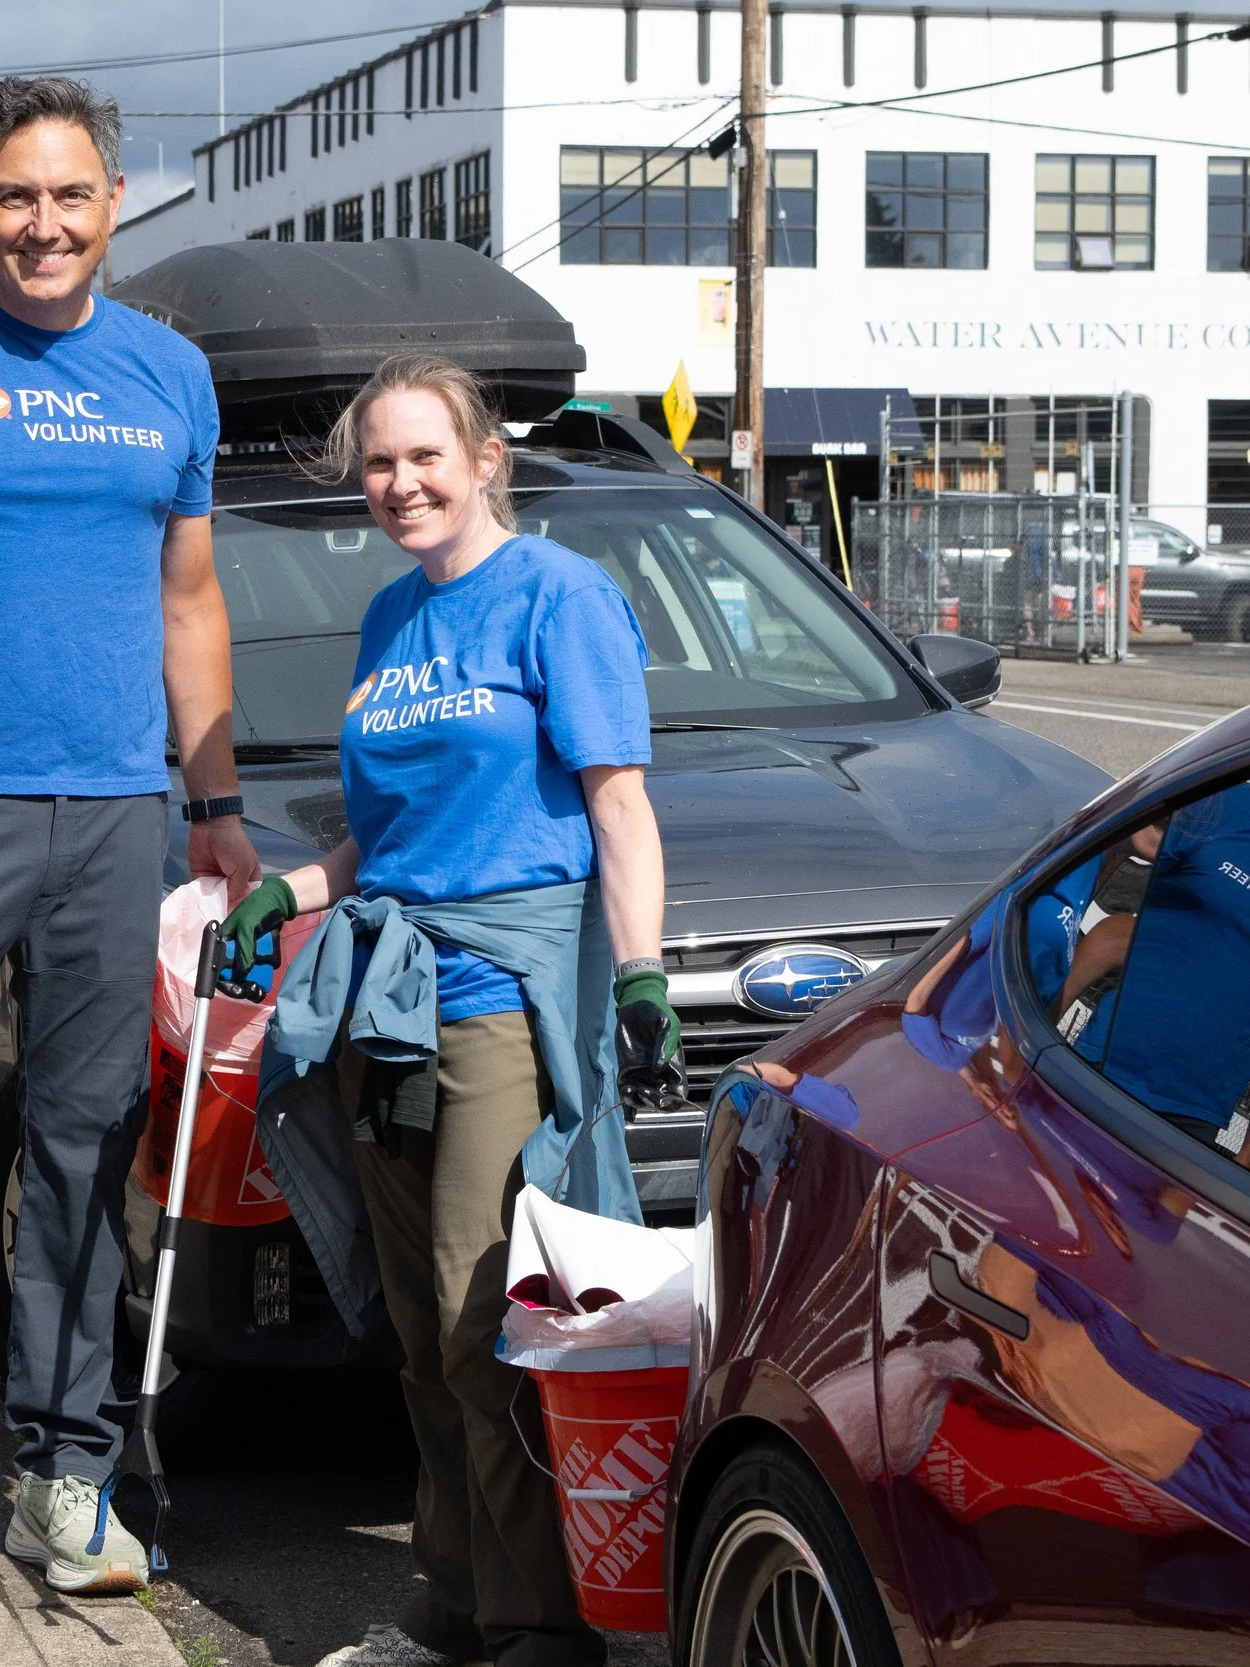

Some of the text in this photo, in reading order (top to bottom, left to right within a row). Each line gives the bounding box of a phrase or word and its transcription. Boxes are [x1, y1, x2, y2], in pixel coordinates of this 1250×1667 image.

[862, 320, 1003, 350] WATER
[1019, 321, 1190, 351] AVENUE
[14, 389, 104, 419] PNC
[23, 422, 165, 450] VOLUNTEER
[372, 656, 449, 702] PNC
[362, 687, 496, 735] VOLUNTEER
[563, 1421, 676, 1581] HOME
[593, 1487, 667, 1588] DEPO
